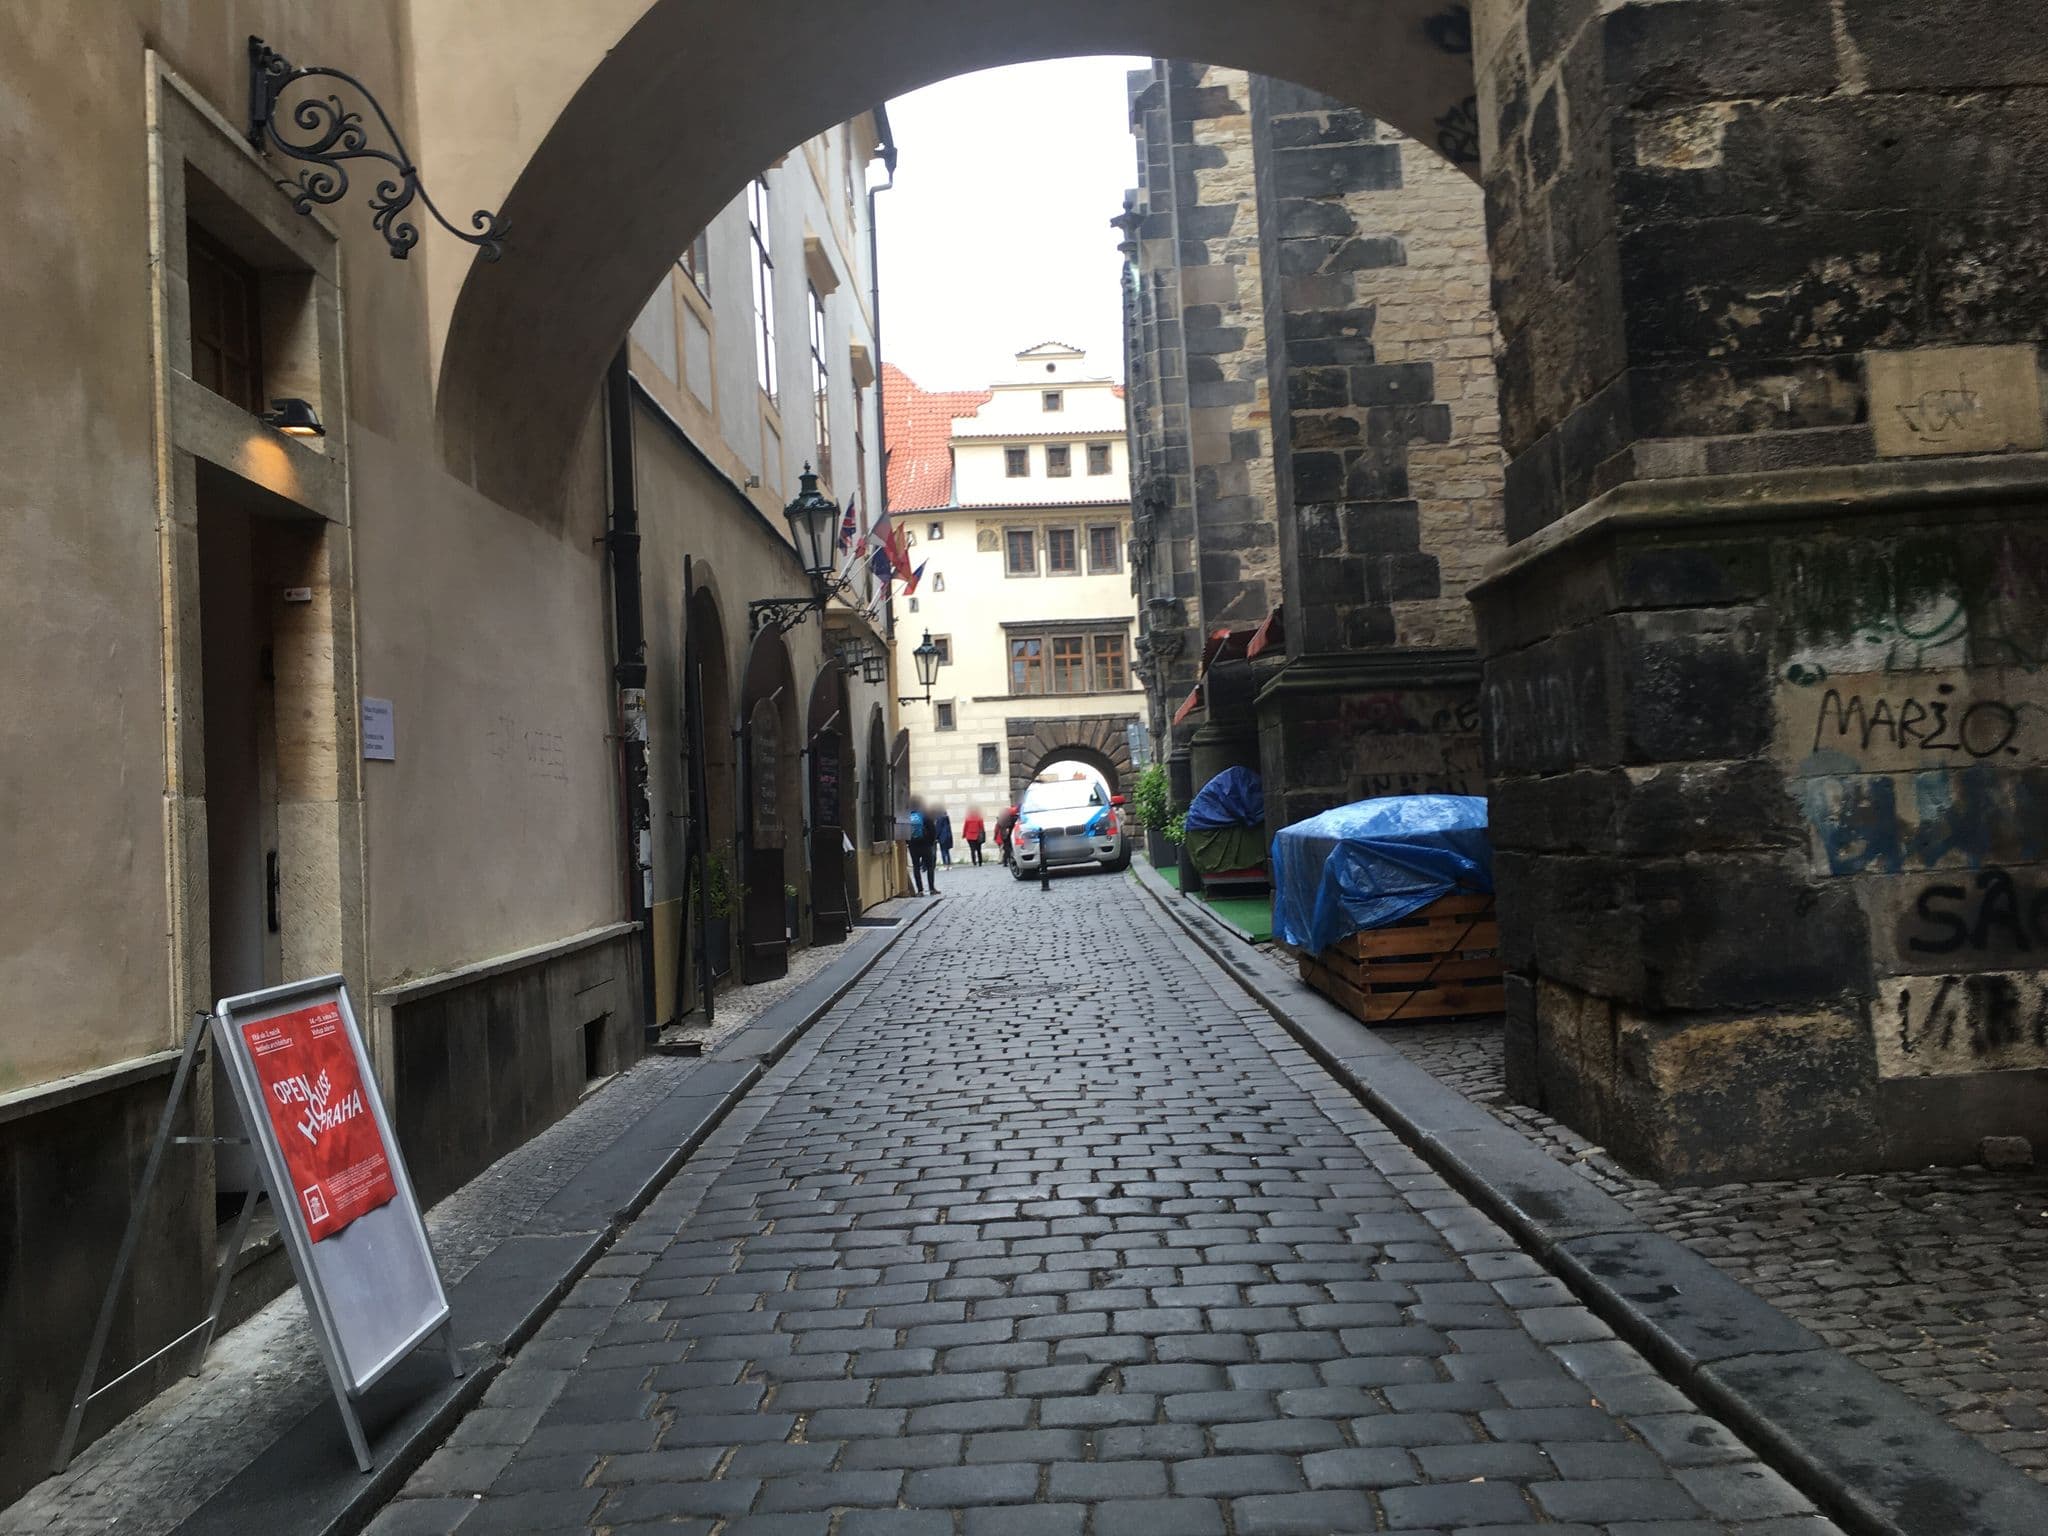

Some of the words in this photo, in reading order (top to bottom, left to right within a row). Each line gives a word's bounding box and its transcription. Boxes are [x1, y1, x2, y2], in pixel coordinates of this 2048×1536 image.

[273, 1074, 310, 1104] OPEN
[297, 1068, 331, 1145] HOUSE
[319, 1089, 363, 1133] PRAHA
